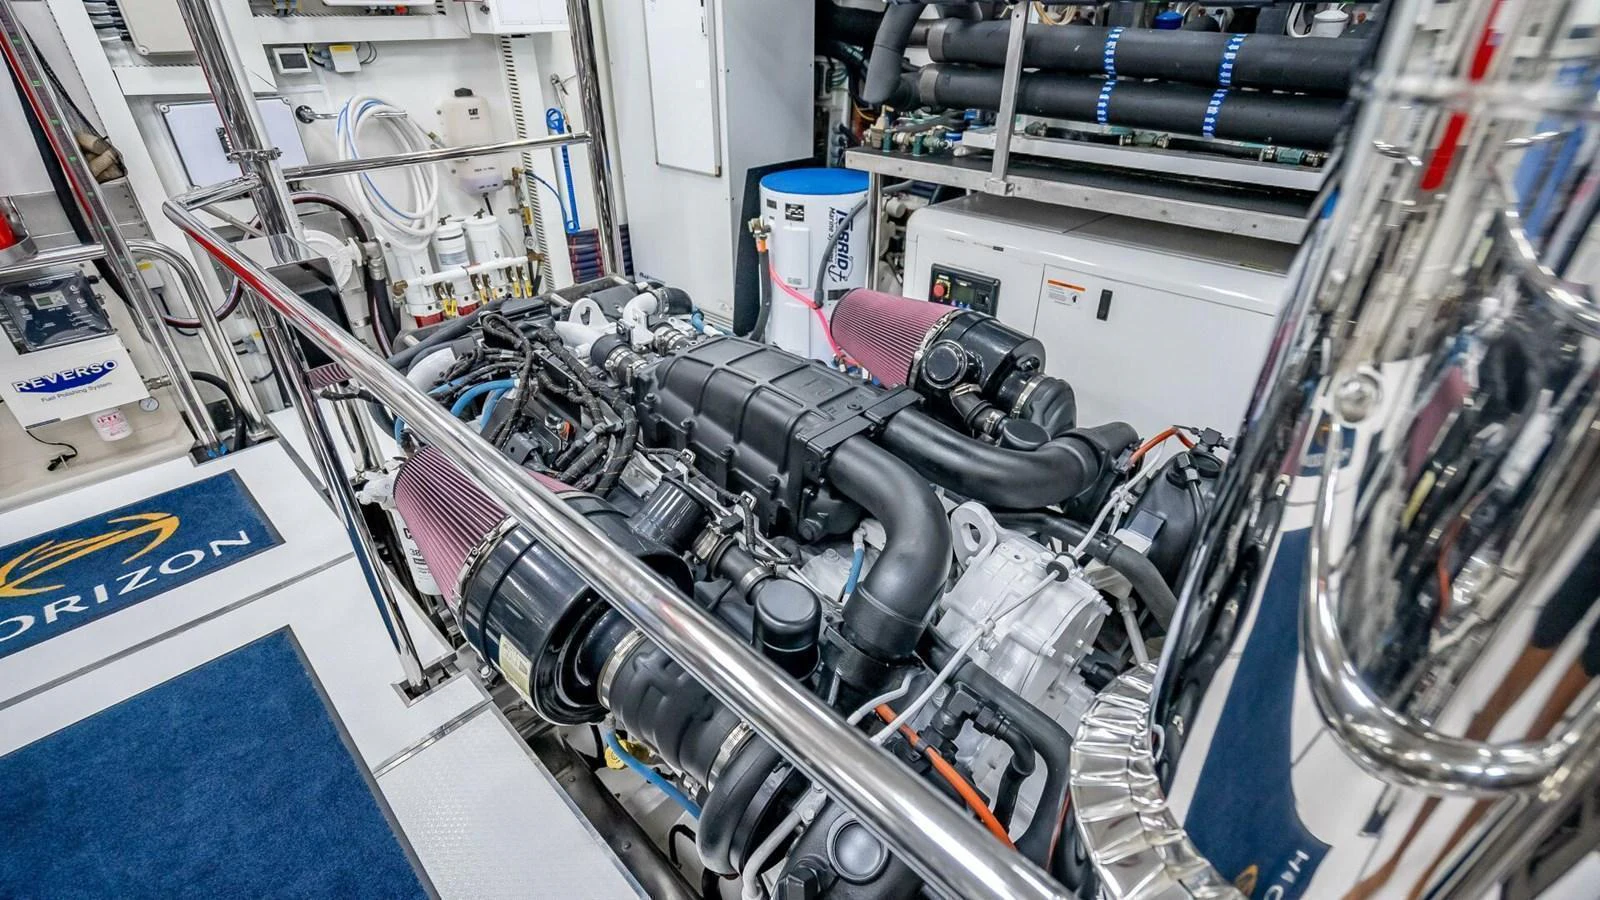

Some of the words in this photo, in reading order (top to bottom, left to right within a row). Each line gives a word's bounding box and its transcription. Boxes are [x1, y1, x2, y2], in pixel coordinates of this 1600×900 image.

[468, 108, 478, 116] CAT
[12, 360, 118, 393] REVERSO
[40, 394, 57, 403] Fuel
[57, 386, 88, 399] Polishing
[88, 381, 113, 391] System
[0, 530, 252, 642] ORIZON
